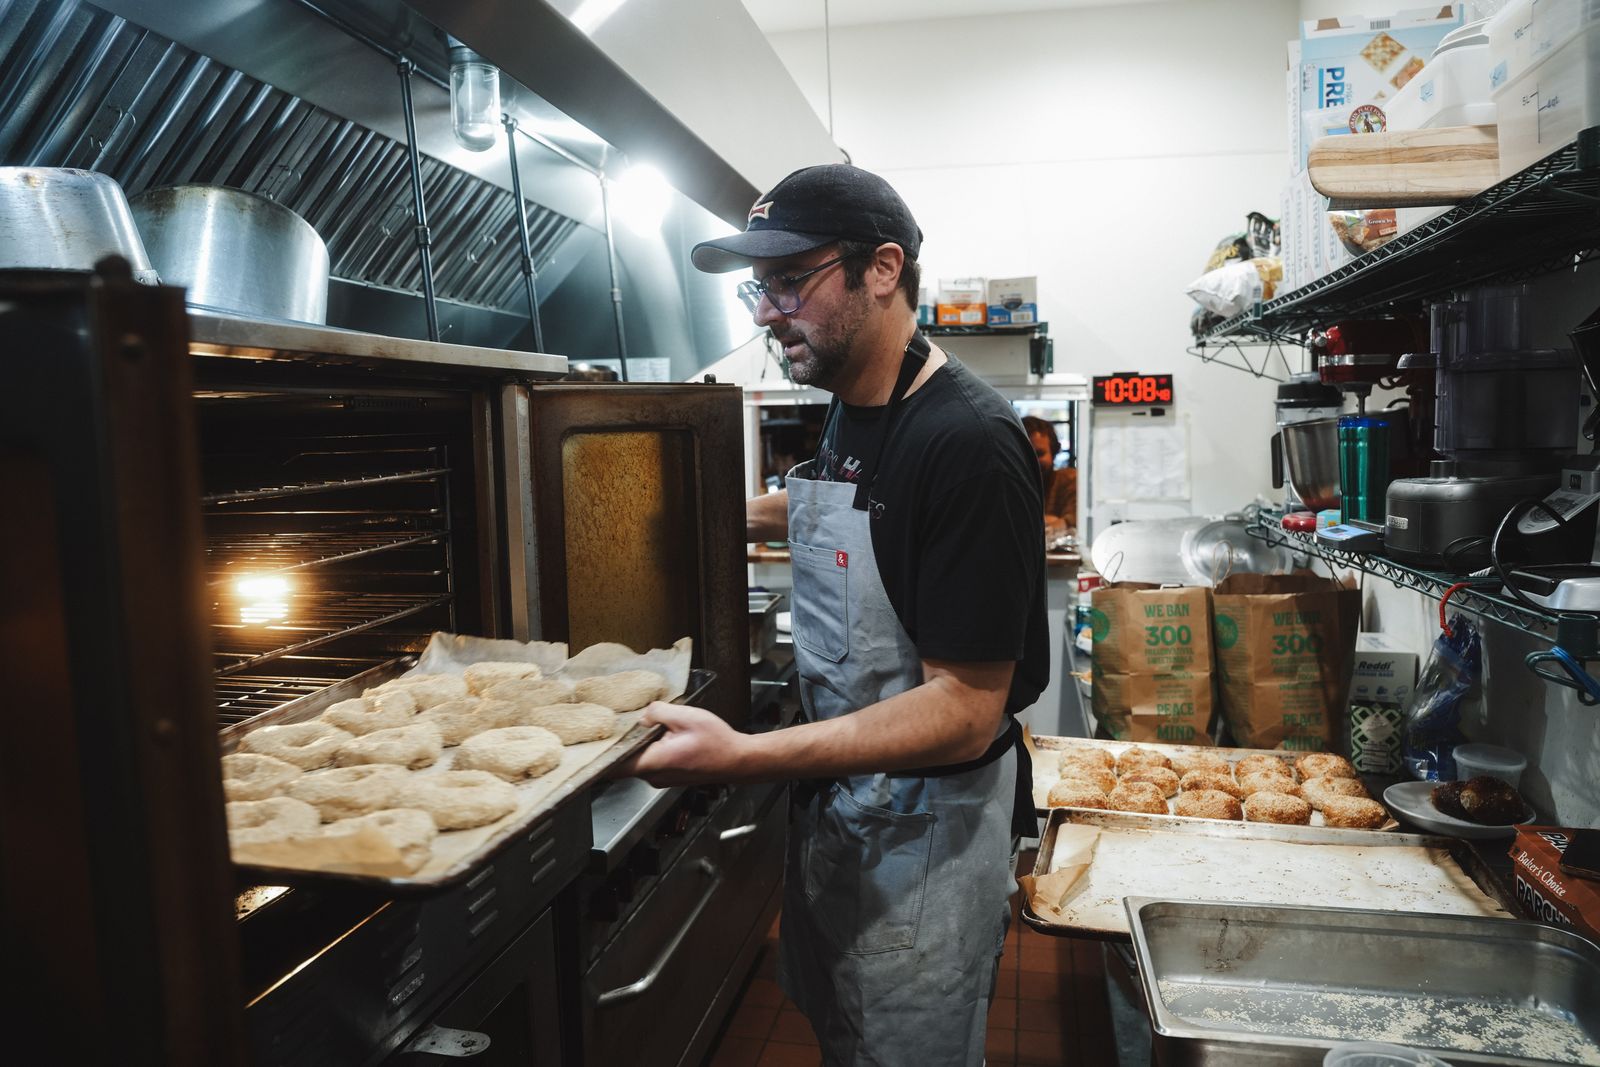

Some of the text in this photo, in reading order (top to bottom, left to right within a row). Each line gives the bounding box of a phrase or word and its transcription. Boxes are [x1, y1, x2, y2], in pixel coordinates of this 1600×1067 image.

[1358, 105, 1374, 115] PLACE
[1104, 377, 1156, 403] 10:08
[1144, 603, 1190, 618] WE BAN
[1273, 612, 1294, 626] WE
[1145, 625, 1192, 646] 300
[1272, 633, 1324, 655] 300
[1358, 661, 1392, 670] Reddi
[1156, 703, 1194, 717] PEACE
[1156, 725, 1196, 741] MIND
[1536, 831, 1568, 854] PA
[1517, 851, 1567, 897] Baker's Choice
